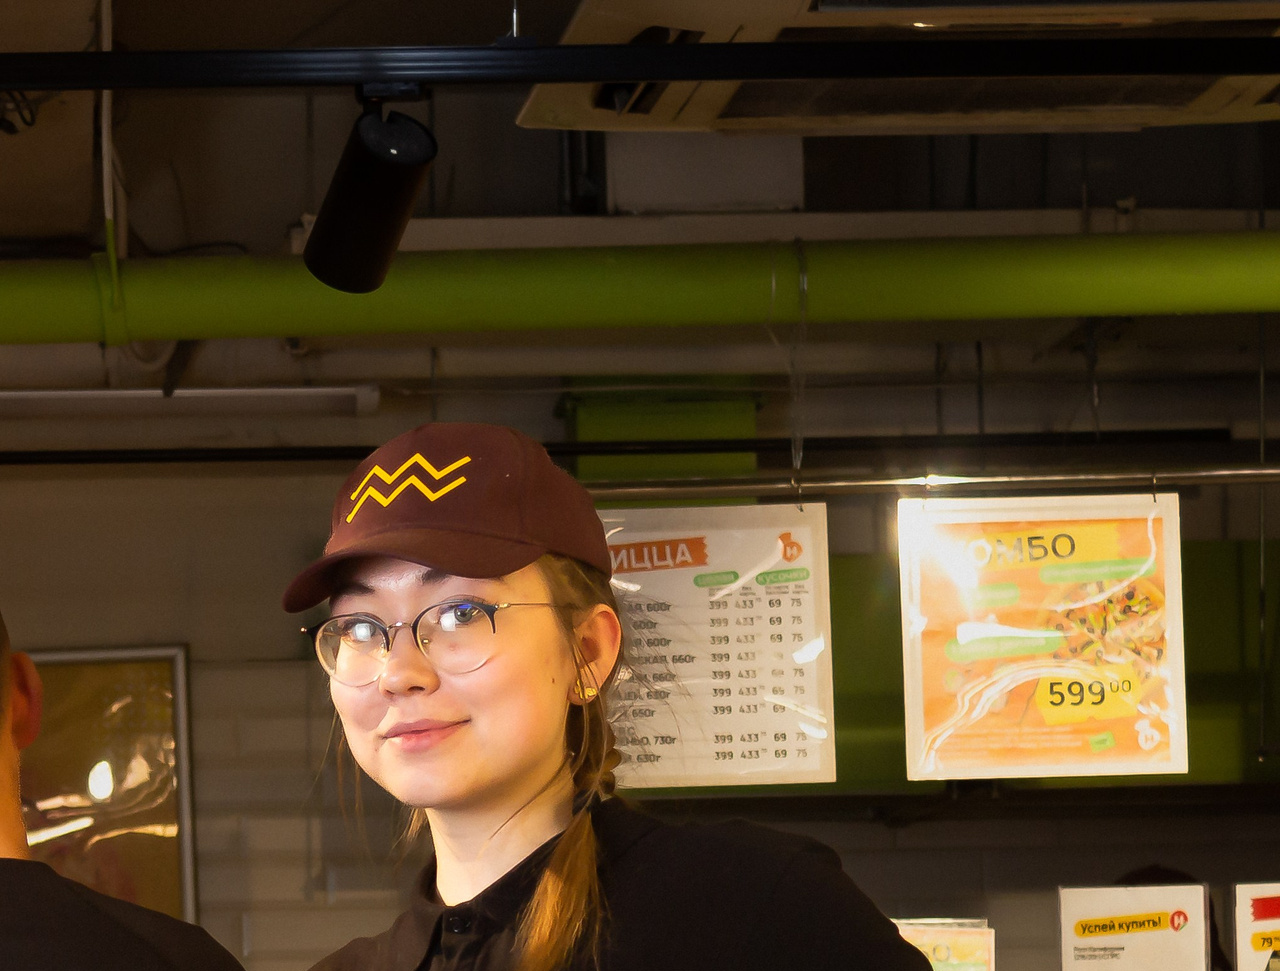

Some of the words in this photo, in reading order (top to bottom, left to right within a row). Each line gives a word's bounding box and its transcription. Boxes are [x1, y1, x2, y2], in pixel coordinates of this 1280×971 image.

[966, 533, 1076, 566] ОМБО
[610, 543, 693, 570] ИЦЦА
[709, 600, 728, 610] 399
[734, 600, 754, 609] 433
[768, 599, 782, 608] 69
[791, 598, 802, 607] 75
[709, 618, 729, 628] 399
[769, 616, 782, 625] 69
[710, 635, 730, 645] 399
[736, 635, 755, 643] 433
[770, 634, 783, 643] 69
[672, 654, 696, 664] 660г
[711, 653, 730, 662] 399
[737, 652, 756, 661] 433
[712, 670, 731, 680] 399
[738, 670, 757, 679] 433
[793, 668, 805, 677] 75
[712, 688, 731, 697] 399
[738, 687, 757, 696] 433
[1049, 680, 1106, 707] 599
[713, 705, 732, 715] 399
[739, 705, 758, 714] 433
[654, 735, 676, 745] 730г
[714, 734, 733, 744] 399
[740, 733, 759, 742] 433
[774, 732, 787, 742] 69
[715, 751, 734, 760] 399
[740, 750, 760, 759] 433
[774, 749, 787, 758] 69
[1080, 920, 1116, 935] Успей
[1118, 916, 1162, 933] купить!
[1260, 937, 1273, 947] 79
